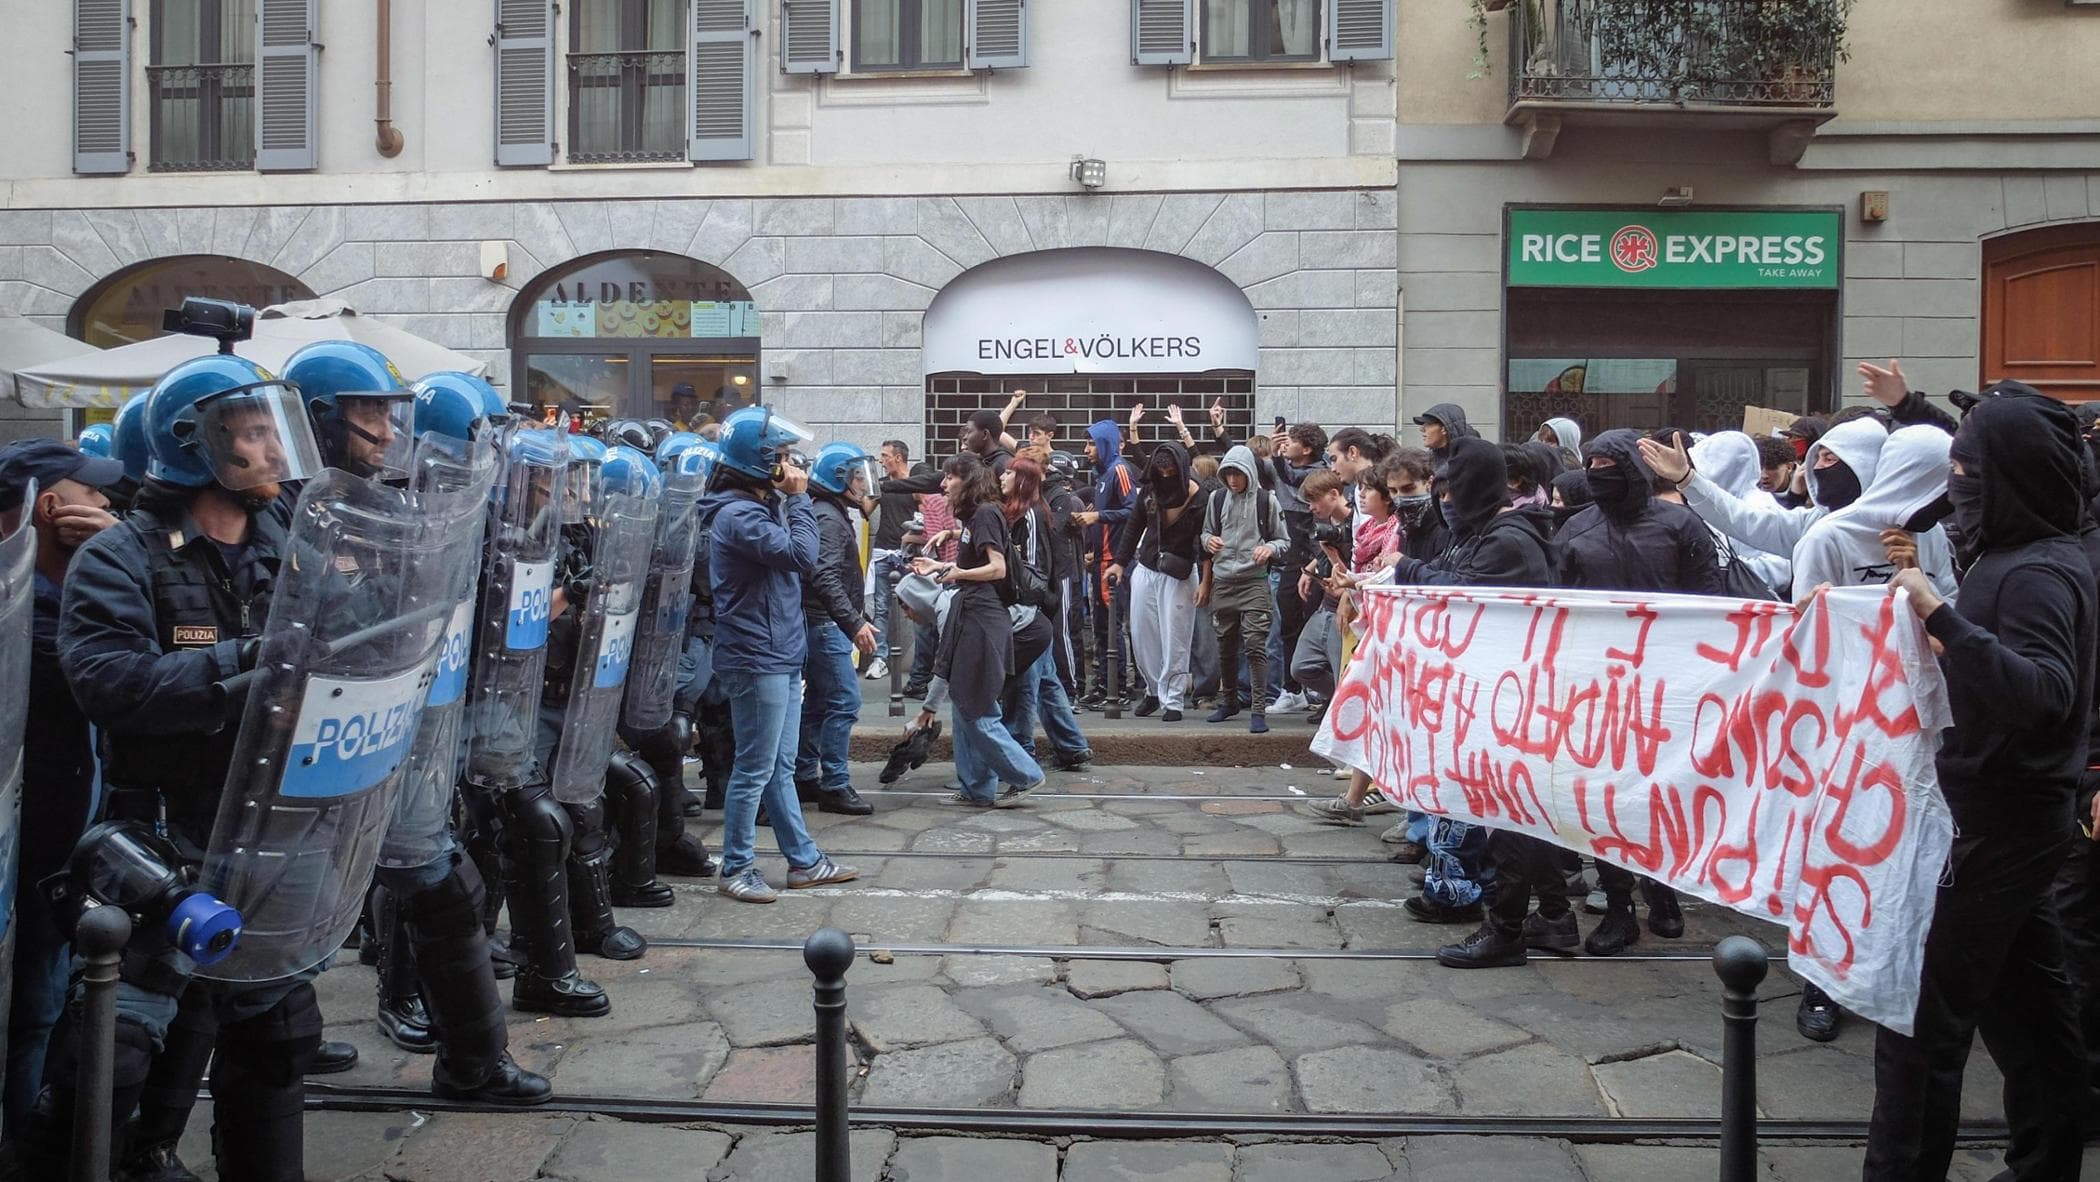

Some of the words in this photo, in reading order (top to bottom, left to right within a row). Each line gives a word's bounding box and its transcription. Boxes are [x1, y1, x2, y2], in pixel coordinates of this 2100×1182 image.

[1521, 234, 1601, 263] RICE
[1665, 235, 1825, 265] EXPRESS
[1758, 268, 1786, 277] TAKE
[1788, 268, 1823, 278] AWAY
[177, 630, 215, 640] POLIZIA
[1491, 664, 1671, 778] ANDATO
[1443, 745, 1559, 836] UNA
[1573, 777, 1760, 905] PUNTI
